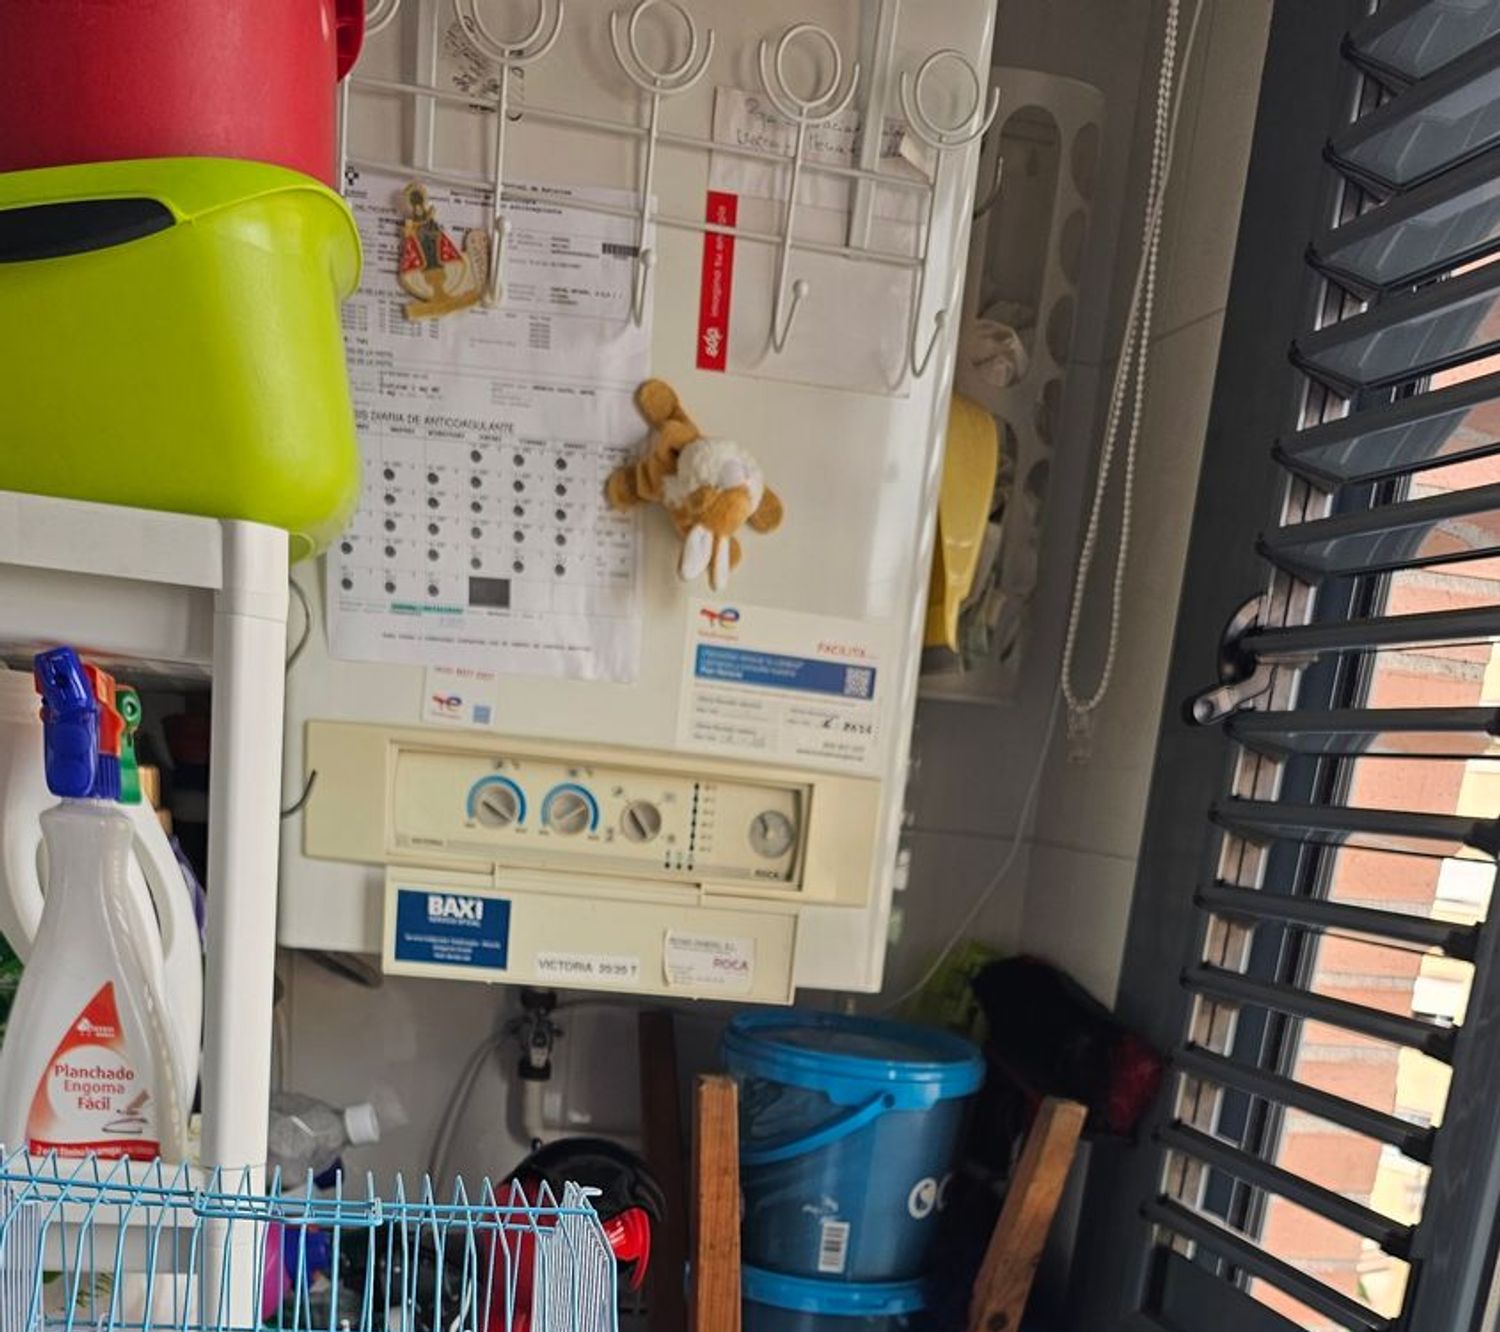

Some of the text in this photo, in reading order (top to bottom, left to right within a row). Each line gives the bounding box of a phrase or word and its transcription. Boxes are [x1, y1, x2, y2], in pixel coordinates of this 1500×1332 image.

[428, 895, 483, 920] BAXI
[538, 958, 593, 974] VICTORIA
[712, 957, 749, 973] ROCA
[55, 1063, 135, 1081] Planchado
[63, 1079, 126, 1097] Engoma
[78, 1096, 111, 1111] Fácil
